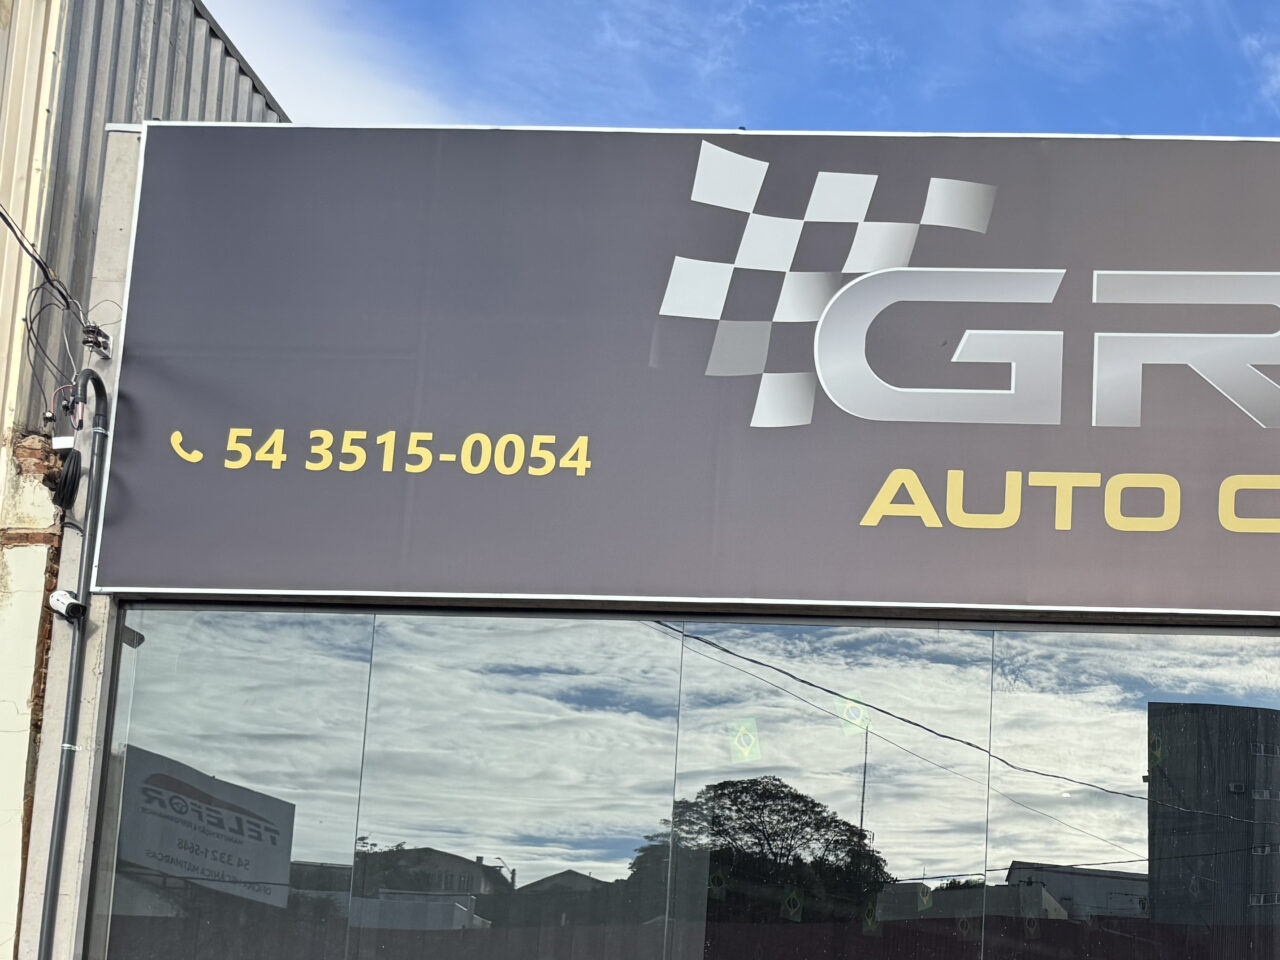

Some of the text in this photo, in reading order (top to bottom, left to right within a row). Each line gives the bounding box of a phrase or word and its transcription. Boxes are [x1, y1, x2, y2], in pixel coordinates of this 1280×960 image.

[223, 428, 592, 477] 54 3515-0054
[860, 469, 1181, 532] AUTO
